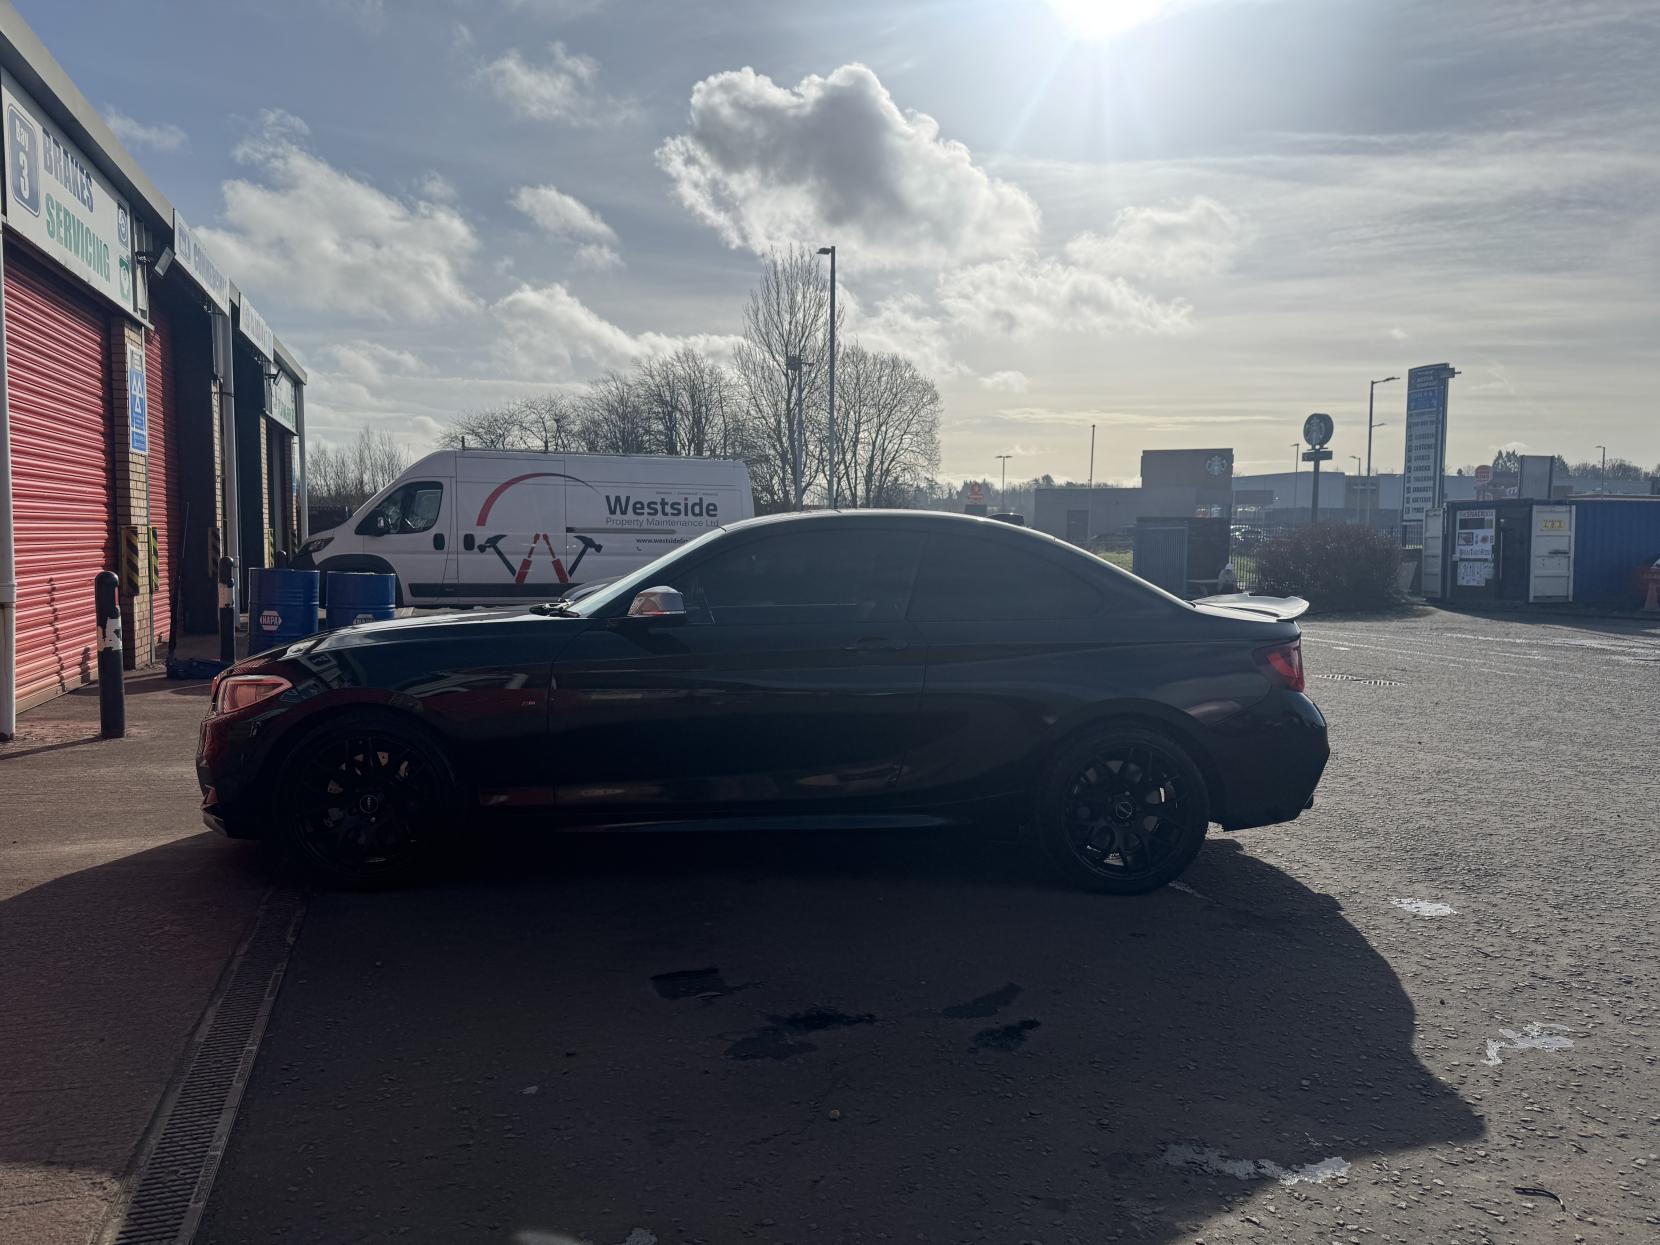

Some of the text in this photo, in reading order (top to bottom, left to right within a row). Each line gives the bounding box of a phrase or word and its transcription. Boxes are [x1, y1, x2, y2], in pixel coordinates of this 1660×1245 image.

[15, 118, 29, 152] Bay
[19, 151, 30, 200] 3
[42, 127, 94, 213] BRAKES
[45, 192, 111, 284] SERVICING
[605, 495, 718, 518] Westside
[605, 517, 719, 528] Property Maintenance Ltd
